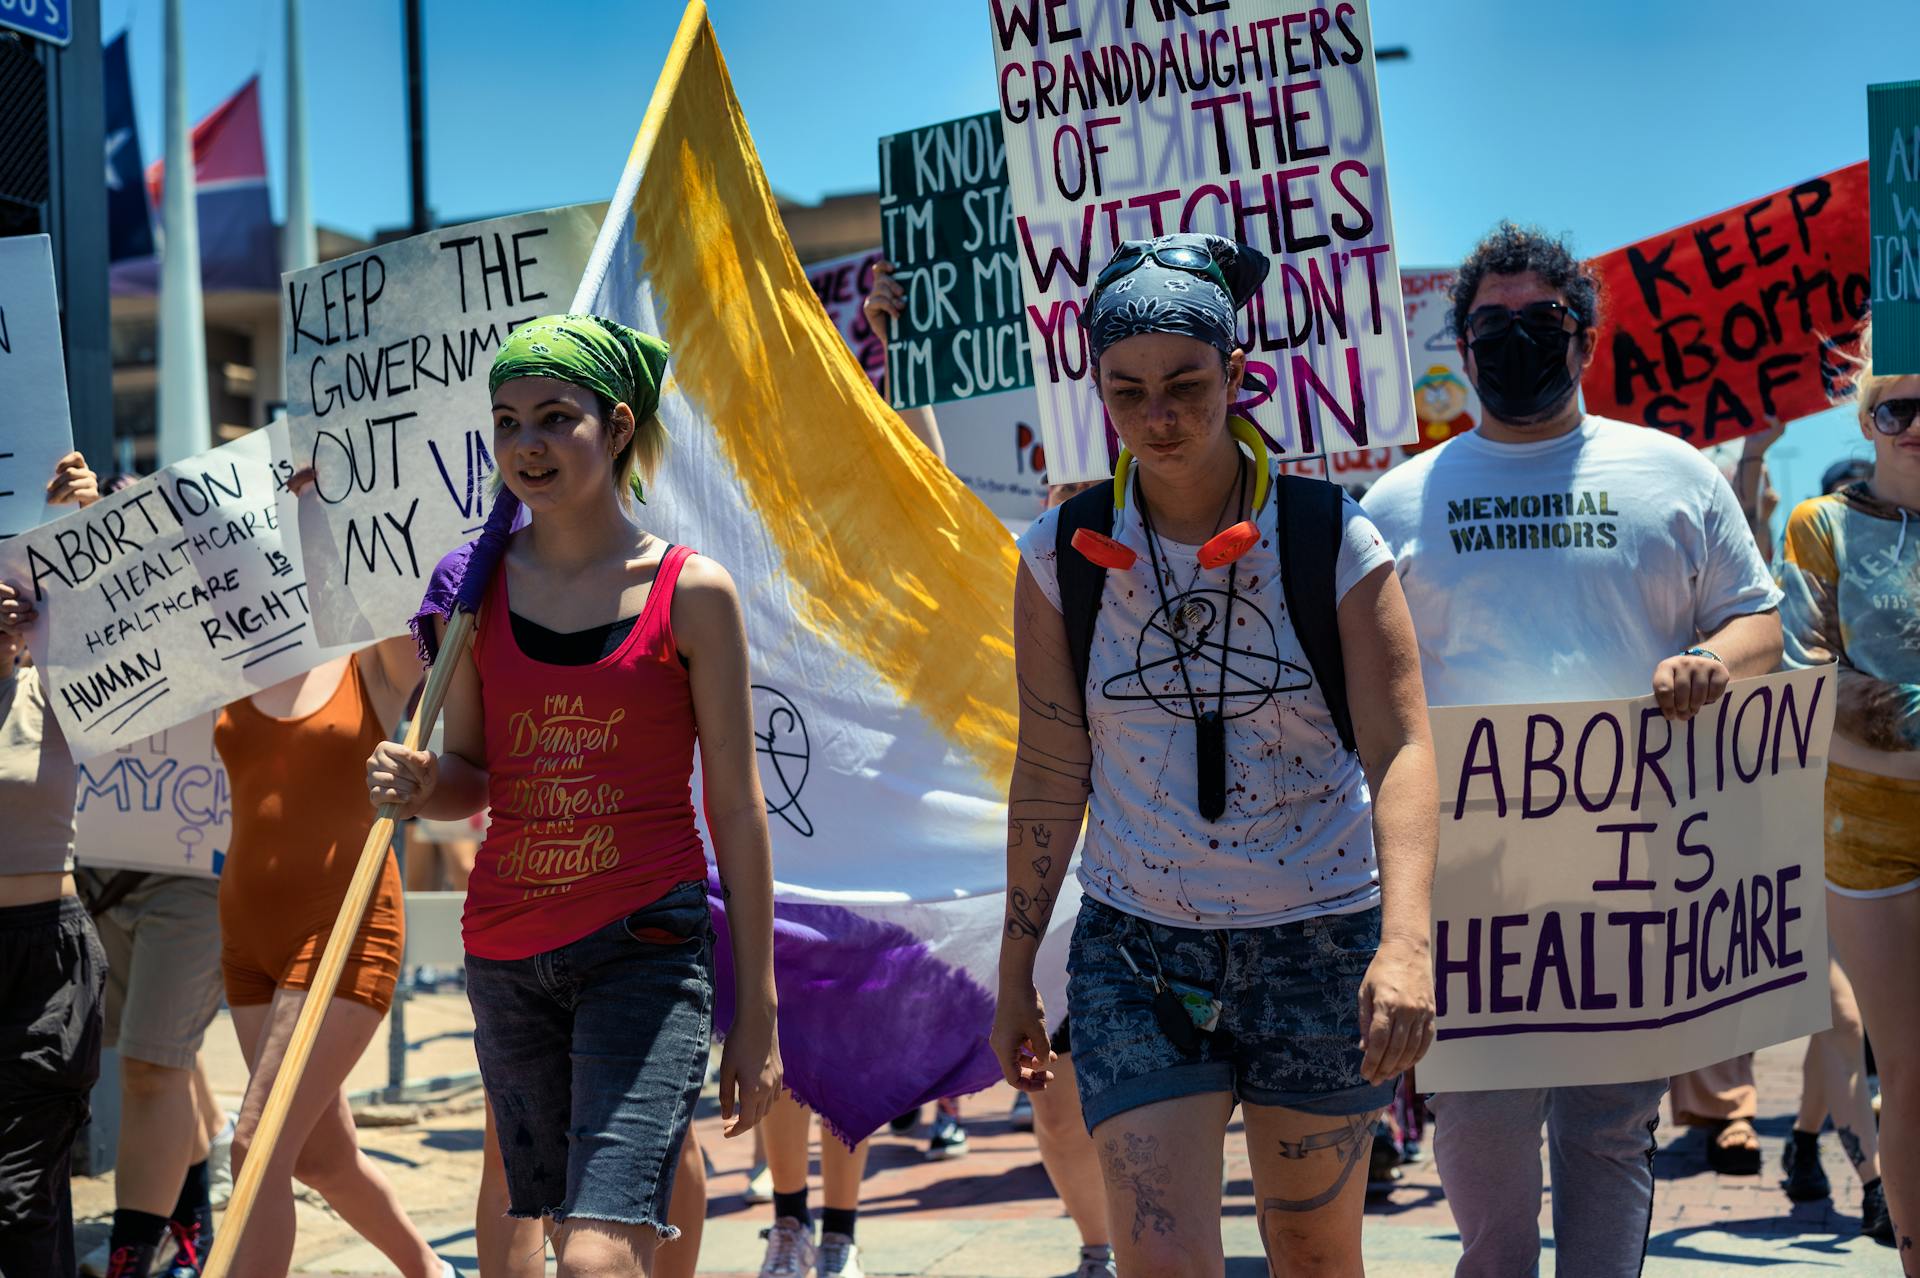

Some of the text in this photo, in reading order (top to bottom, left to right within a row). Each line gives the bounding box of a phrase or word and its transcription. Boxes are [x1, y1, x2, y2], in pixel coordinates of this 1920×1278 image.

[1001, 3, 1363, 124] GRANDDAUGHTERS
[880, 136, 899, 205] I
[1053, 80, 1330, 202] OF THE
[883, 199, 936, 268] I'M
[1017, 160, 1374, 293] WITCHES
[1626, 178, 1831, 320] KEEP
[288, 228, 549, 354] KEEP THE
[888, 337, 936, 409] I'M
[1643, 332, 1858, 440] SAFE
[312, 412, 418, 504] OUT
[1447, 491, 1618, 524] MEMORIAL
[25, 462, 243, 602] ABORTION
[99, 503, 279, 612] HEALTHCARE
[344, 498, 420, 586] MY
[1449, 522, 1617, 554] WARRIORS
[59, 583, 310, 722] HUMAN RIGHT
[85, 568, 241, 654] HEALTHCARE
[544, 695, 585, 716] I'M A
[1454, 676, 1826, 819] ABORTION
[496, 824, 621, 884] Handle
[1592, 812, 1714, 892] IS
[1434, 864, 1804, 1017] HEALTHCARE
